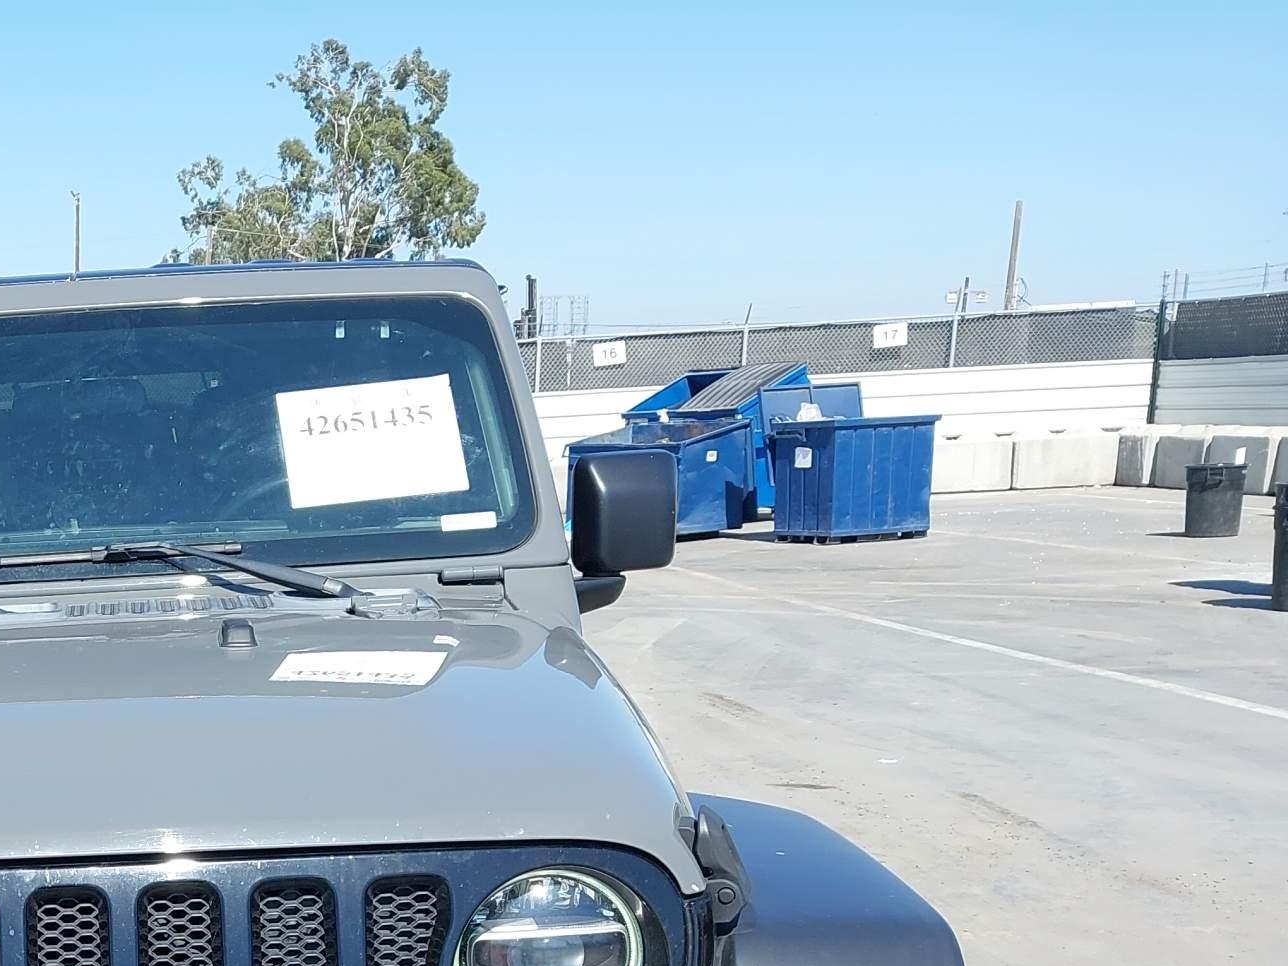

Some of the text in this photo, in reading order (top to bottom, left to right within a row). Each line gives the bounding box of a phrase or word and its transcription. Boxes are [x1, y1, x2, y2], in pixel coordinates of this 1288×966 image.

[883, 329, 899, 341] 17
[602, 347, 617, 360] 16
[299, 404, 433, 436] 42651435
